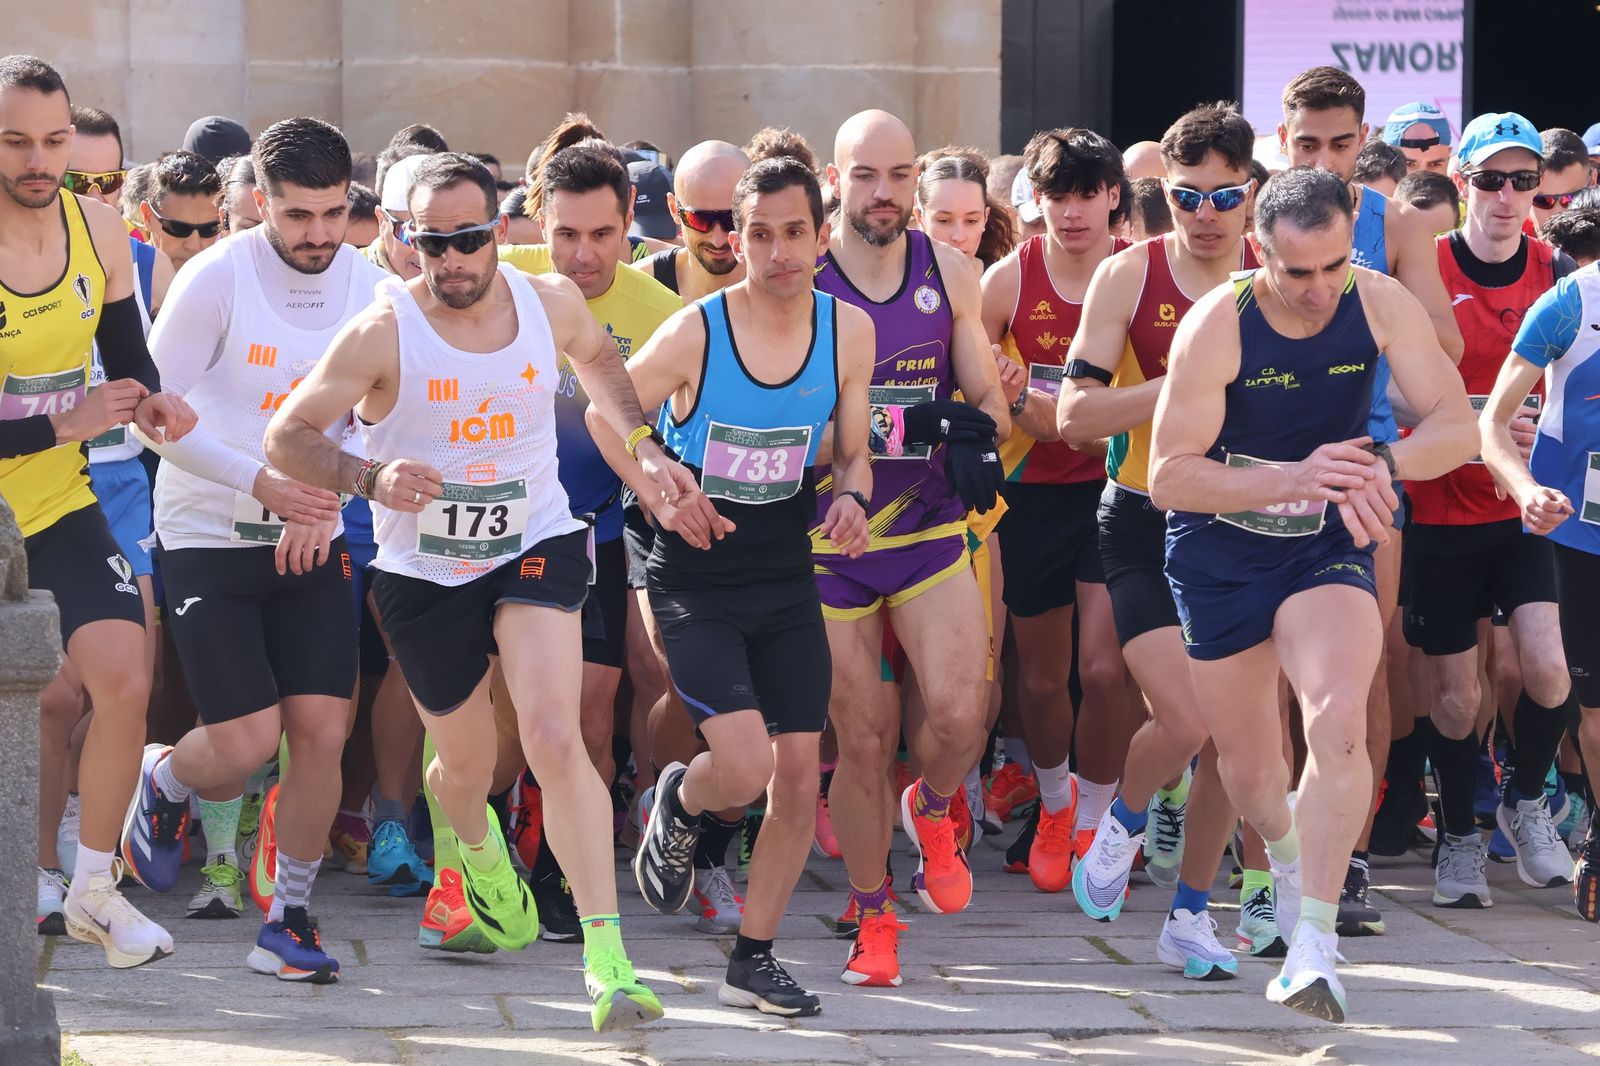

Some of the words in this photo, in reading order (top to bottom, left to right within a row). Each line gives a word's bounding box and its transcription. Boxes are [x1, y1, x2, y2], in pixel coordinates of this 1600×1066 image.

[22, 310, 37, 319] CCI
[37, 300, 62, 315] SPORT
[80, 308, 95, 319] GCB
[896, 356, 936, 371] PRIM
[1261, 367, 1277, 376] C.D.
[726, 446, 788, 481] 733
[442, 503, 509, 538] 173
